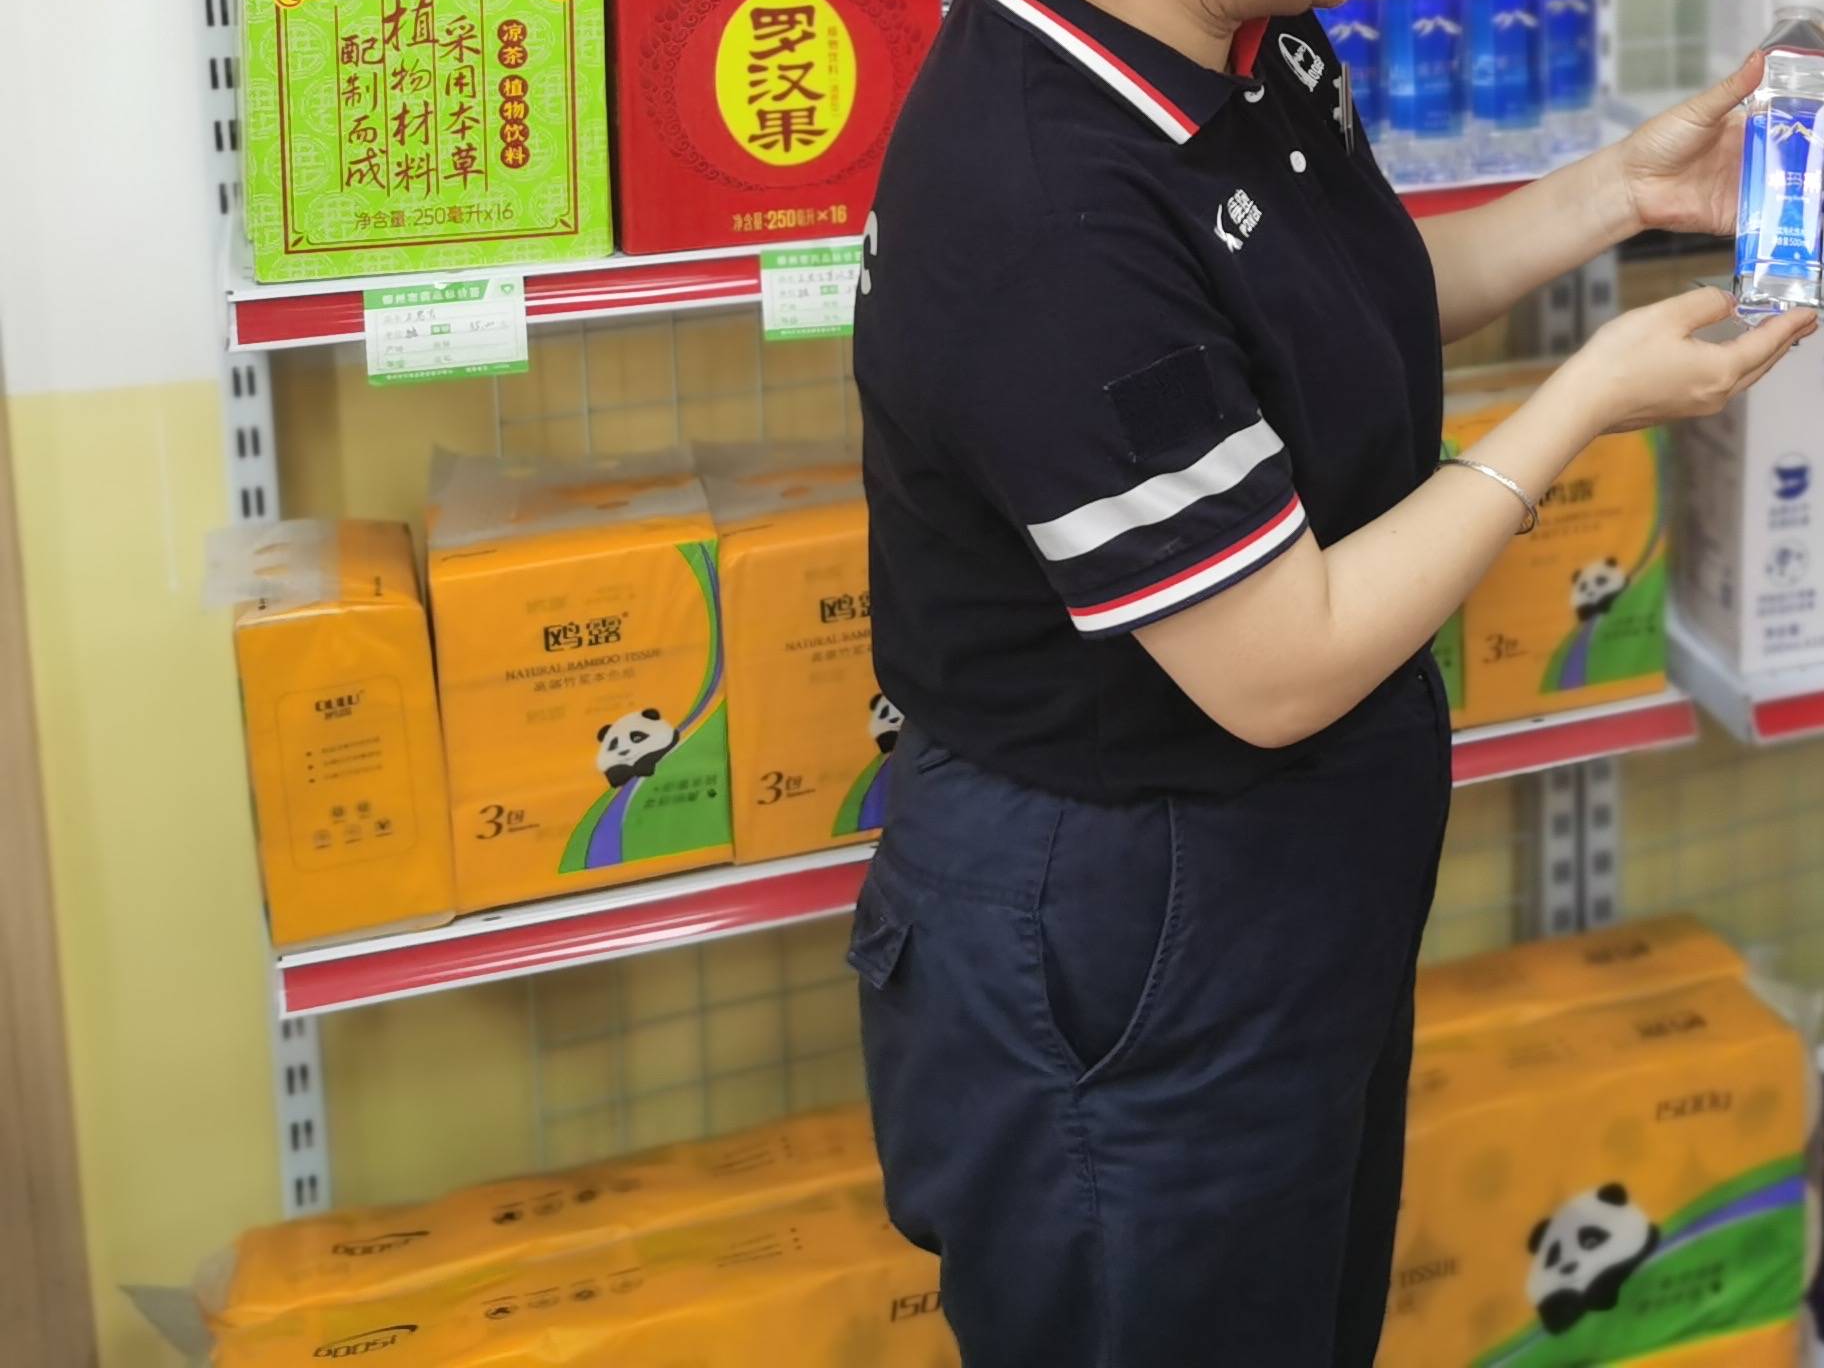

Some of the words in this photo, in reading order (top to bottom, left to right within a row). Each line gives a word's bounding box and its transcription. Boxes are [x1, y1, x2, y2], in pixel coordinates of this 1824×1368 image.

[339, 33, 387, 191] 配制而成
[439, 14, 486, 190] 采用本草
[500, 21, 525, 69] 凉茶
[747, 4, 829, 154] 罗汉果
[501, 76, 528, 167] 植物饮料
